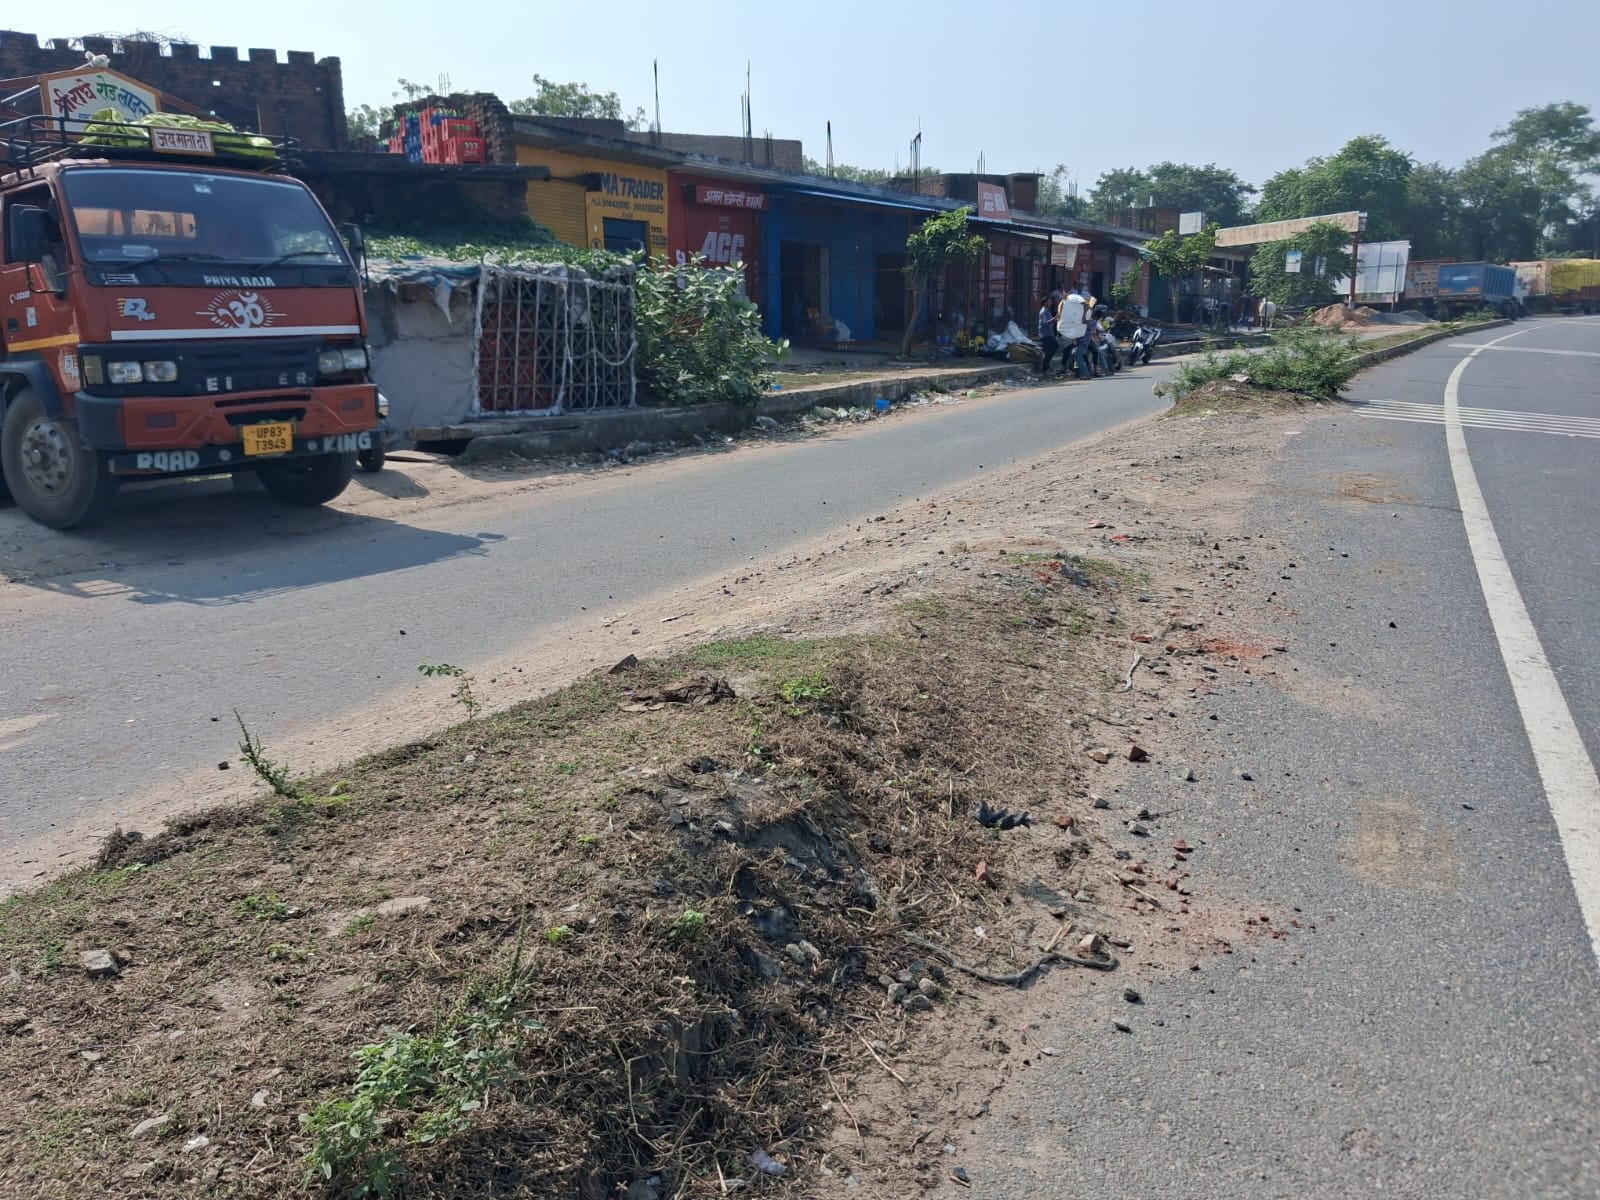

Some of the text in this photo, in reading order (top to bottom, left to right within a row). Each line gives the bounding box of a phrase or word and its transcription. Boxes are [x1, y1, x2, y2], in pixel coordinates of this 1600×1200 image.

[620, 177, 664, 200] TRADER
[701, 231, 745, 263] ACC
[203, 275, 276, 287] PRIYA RAJA
[323, 432, 372, 453] KING
